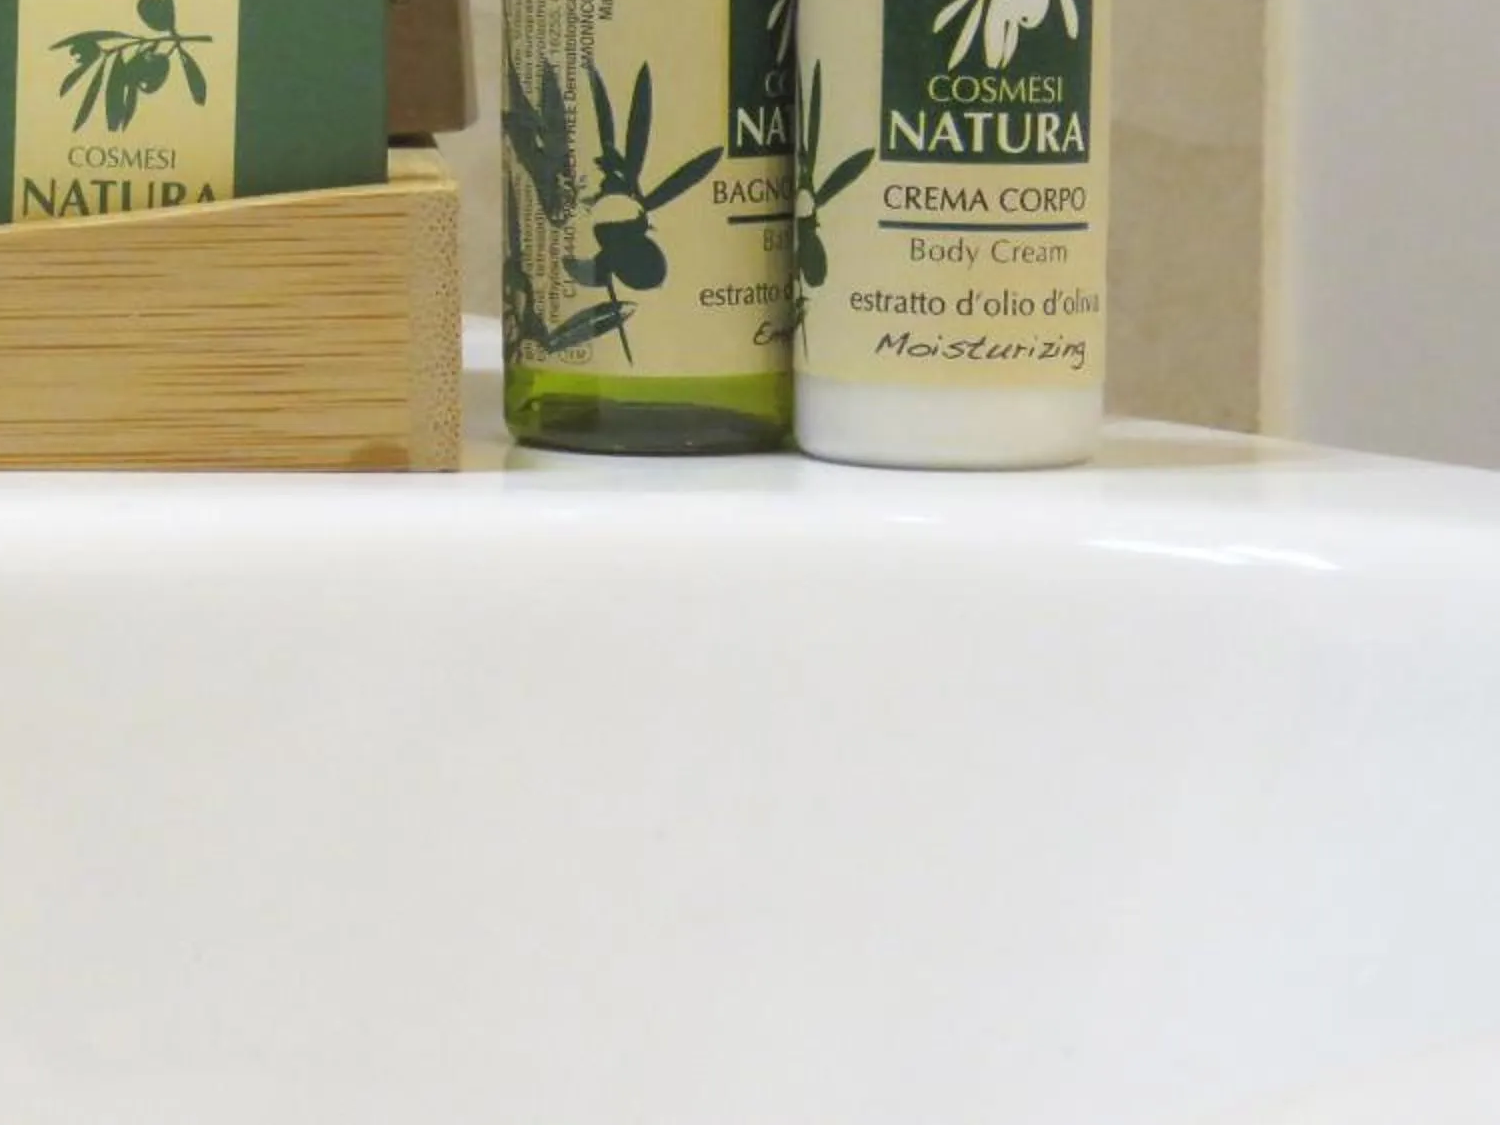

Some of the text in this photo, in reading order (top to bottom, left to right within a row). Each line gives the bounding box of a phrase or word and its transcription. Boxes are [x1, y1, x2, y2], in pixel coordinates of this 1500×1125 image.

[927, 74, 1063, 103] COSMESI
[887, 110, 1086, 154] NATURA
[67, 145, 177, 170] COSMESI
[882, 184, 1086, 213] CREMA CORPO
[910, 237, 1069, 269] Body Cream
[699, 282, 780, 307] estratto
[849, 288, 946, 317] estratto
[955, 287, 1036, 318] d'olio
[874, 332, 1087, 371] Moisturizing
